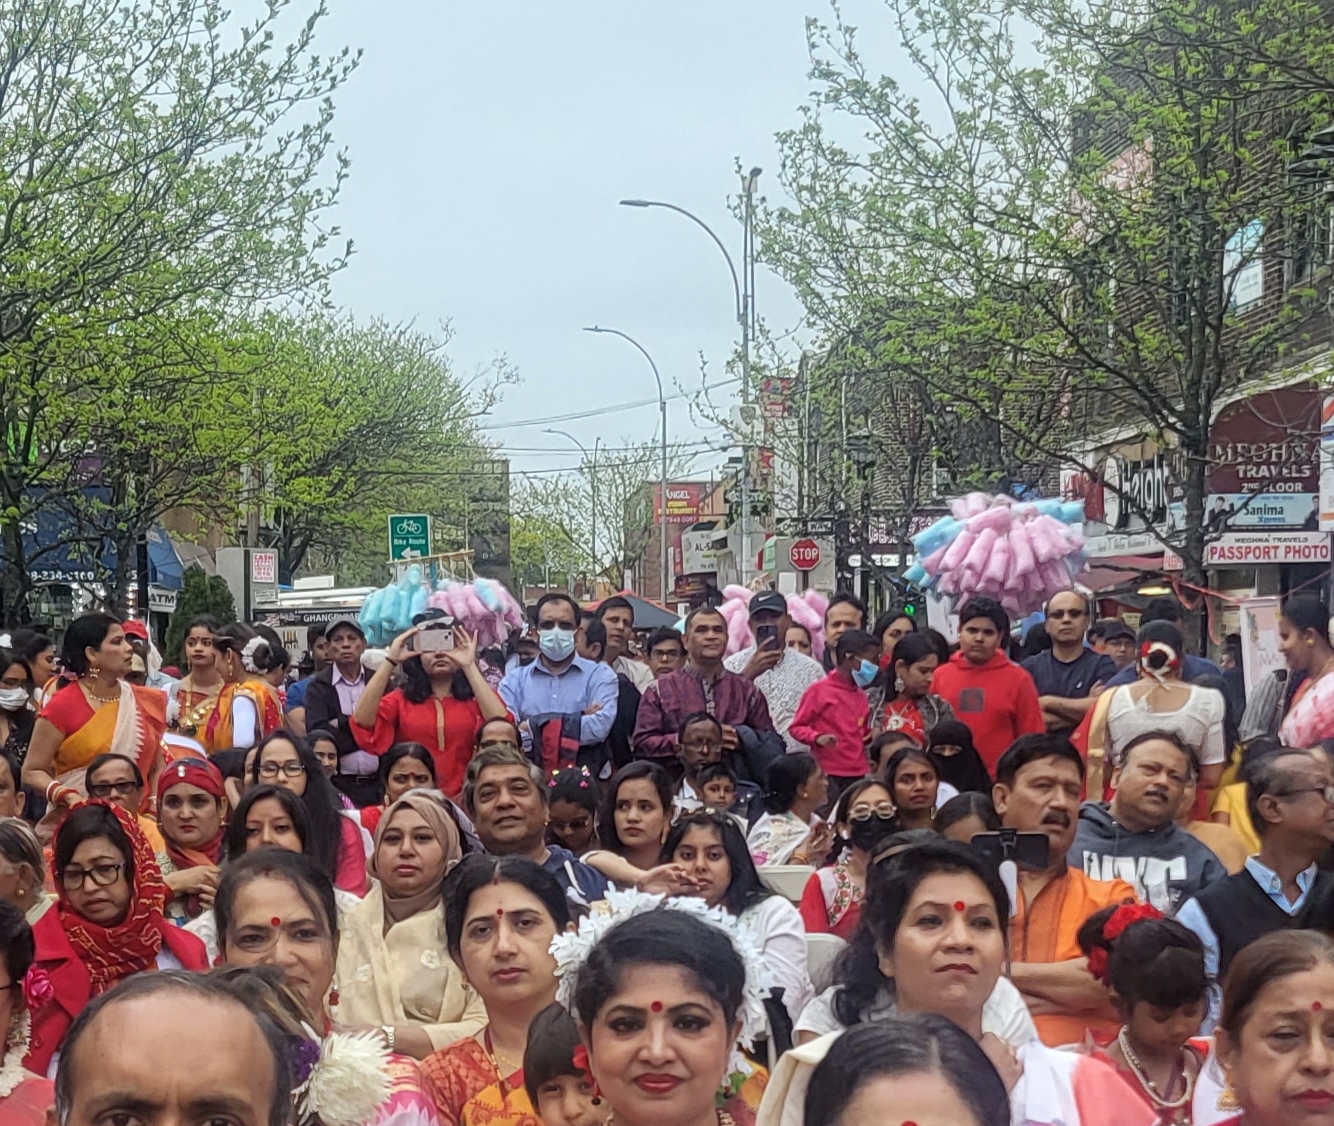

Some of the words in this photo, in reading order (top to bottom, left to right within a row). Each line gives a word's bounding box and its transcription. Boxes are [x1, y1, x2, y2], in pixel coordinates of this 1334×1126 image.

[1215, 442, 1321, 462] MEGHNA
[1236, 465, 1311, 478] TRAVELS
[1244, 503, 1284, 516] Sanima
[394, 538, 407, 546] Bike
[408, 538, 426, 546] Route
[792, 547, 818, 560] STOP
[1210, 545, 1280, 560] PASSPORT
[1284, 544, 1329, 559] PHOTO
[149, 594, 176, 604] ATM
